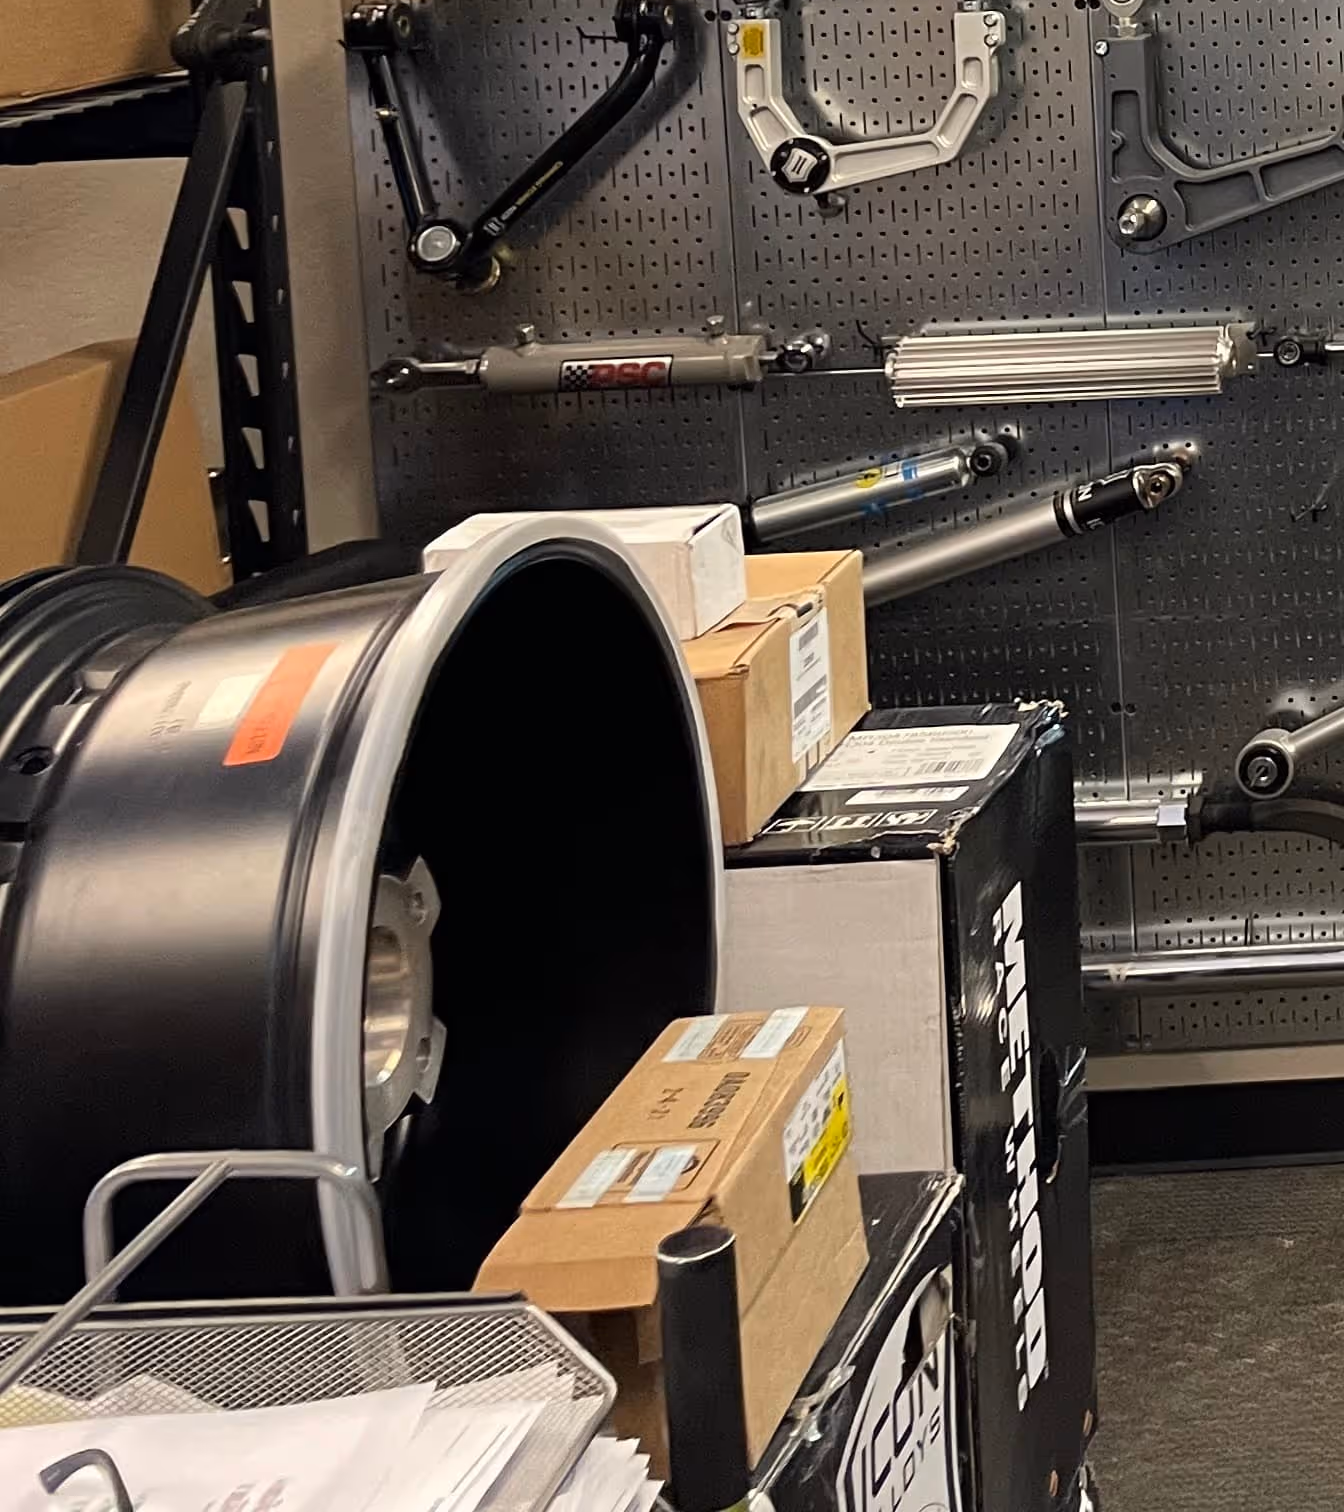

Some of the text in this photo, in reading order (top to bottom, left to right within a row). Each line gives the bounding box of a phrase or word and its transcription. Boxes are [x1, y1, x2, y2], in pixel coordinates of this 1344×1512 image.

[992, 906, 1012, 1092] RACE
[1002, 881, 1048, 1390] METHOD
[1005, 1125, 1032, 1412] WHEELS
